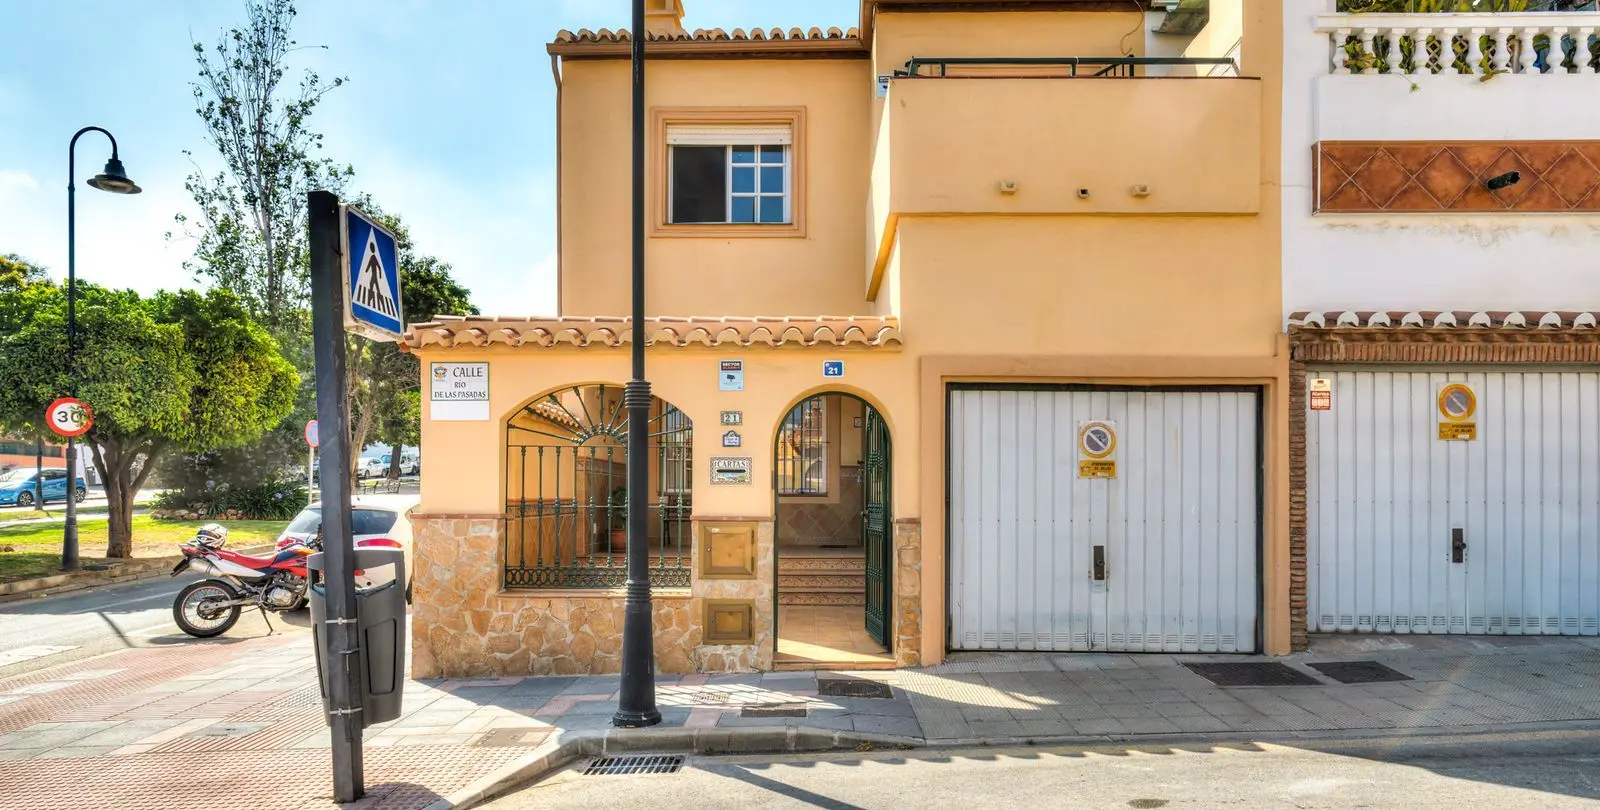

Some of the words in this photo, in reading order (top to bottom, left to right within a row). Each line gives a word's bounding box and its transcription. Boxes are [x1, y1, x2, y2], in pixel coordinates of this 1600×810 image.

[453, 366, 483, 378] CALLE
[828, 367, 838, 375] 21
[458, 391, 486, 399] PASADAS
[57, 410, 81, 423] 30
[724, 414, 737, 422] 21
[718, 460, 746, 468] CARTAS
